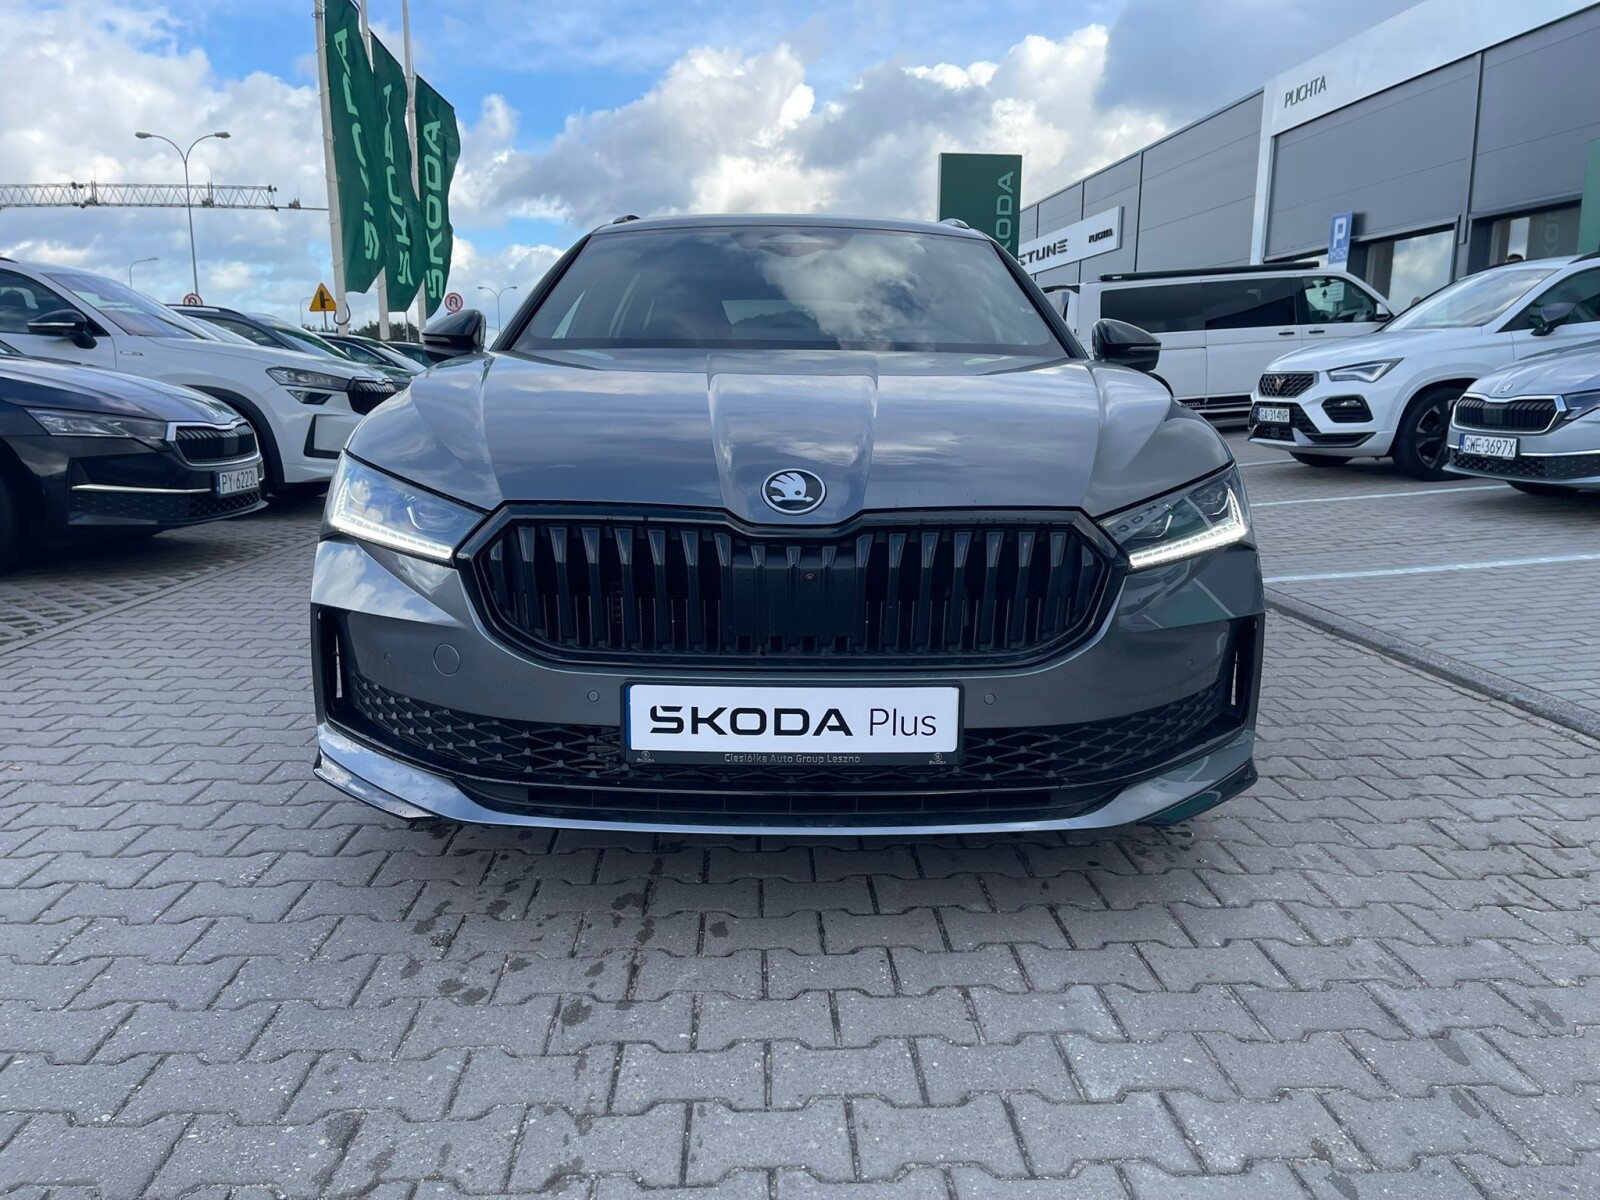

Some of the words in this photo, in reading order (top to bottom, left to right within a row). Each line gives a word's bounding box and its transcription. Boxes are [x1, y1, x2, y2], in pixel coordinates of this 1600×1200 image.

[995, 170, 1014, 250] ODA
[1018, 238, 1068, 267] STUNE
[1464, 436, 1482, 453] GWE
[1484, 438, 1515, 456] 3697X
[222, 473, 233, 493] PY
[869, 708, 937, 737] Plus
[769, 754, 793, 763] Auto
[796, 754, 824, 765] Group
[827, 754, 861, 763] Leszno
